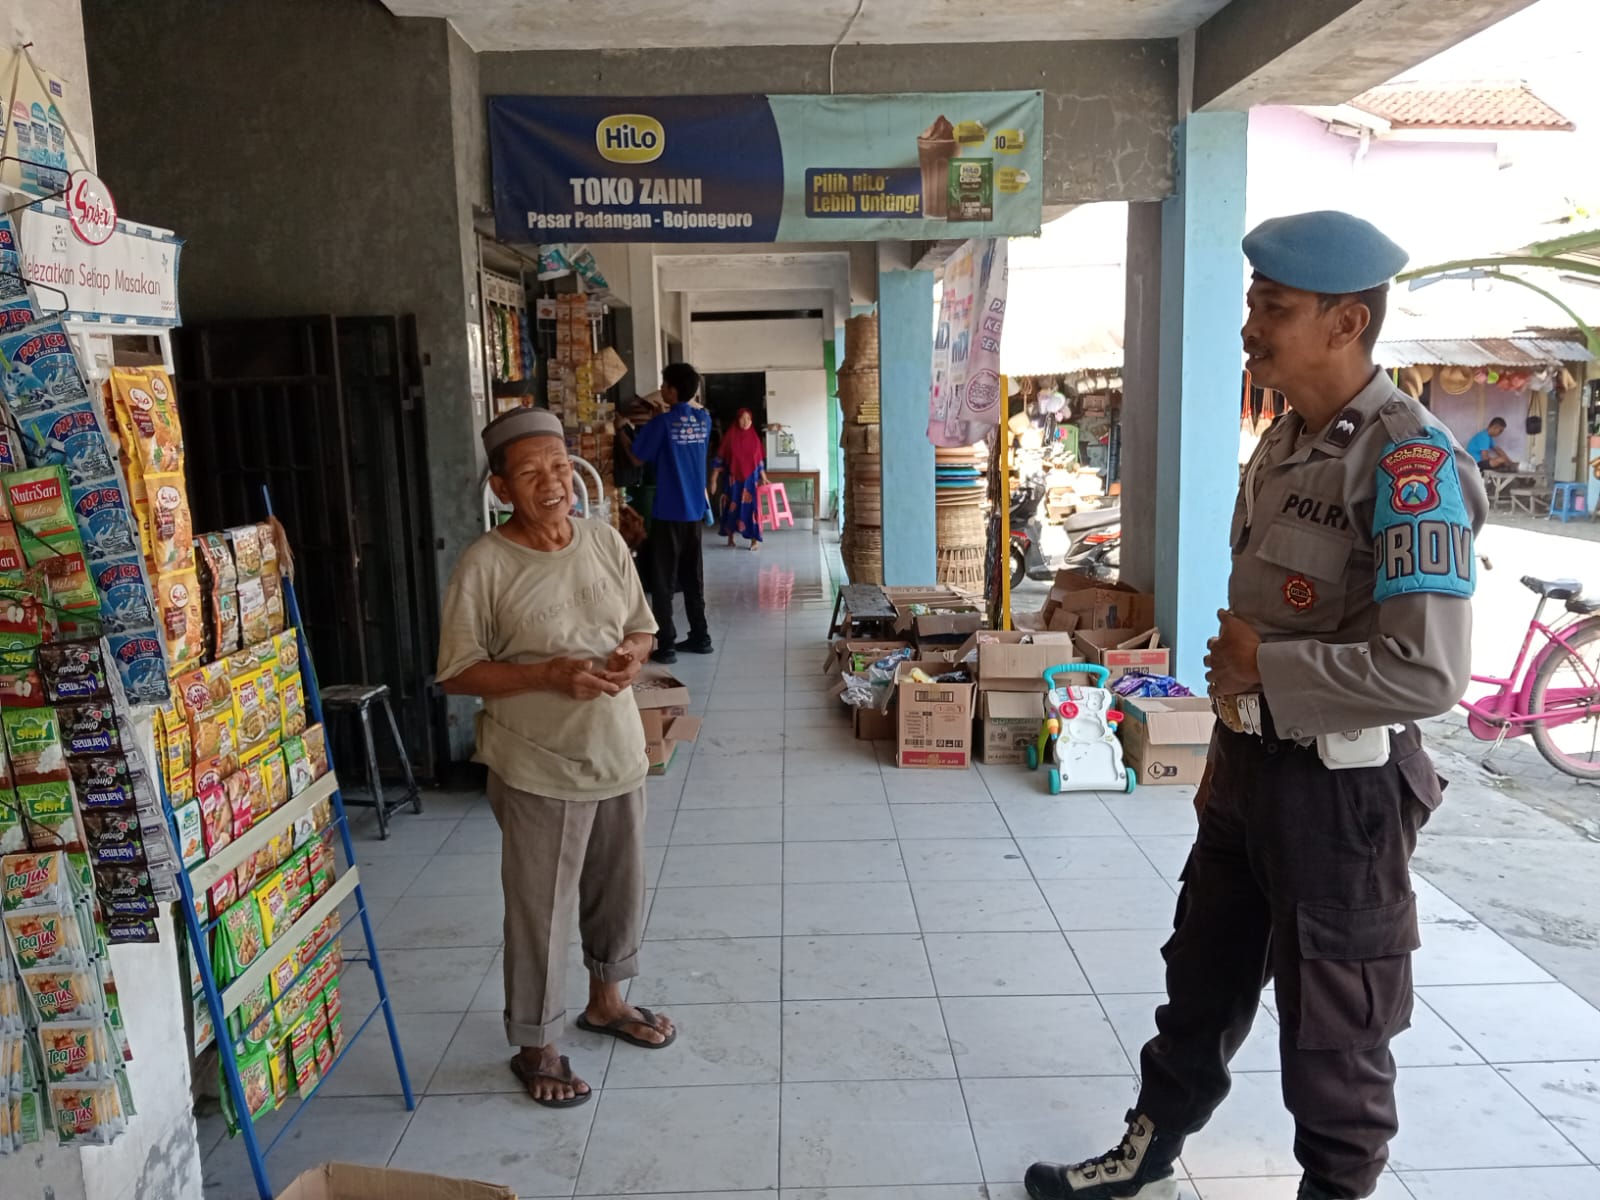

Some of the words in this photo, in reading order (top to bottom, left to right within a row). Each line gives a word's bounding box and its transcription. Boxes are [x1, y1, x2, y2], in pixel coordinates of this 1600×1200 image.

[605, 124, 657, 149] HiLo
[569, 177, 634, 206] TOKO
[638, 177, 703, 206] ZAINI
[813, 173, 848, 193] Pilih
[813, 193, 856, 213] Lebih
[860, 191, 920, 214] Untung!
[527, 211, 572, 229] Pasar
[574, 210, 652, 230] Padangan
[663, 210, 753, 230] Bojonegoro
[79, 262, 111, 296] Setiap
[115, 268, 161, 296] Masakan
[18, 337, 42, 363] POP
[42, 333, 66, 349] ICE
[53, 415, 74, 440] POP
[1385, 446, 1441, 464] POLRES
[10, 483, 57, 505] NutriSari
[79, 491, 100, 513] POP
[71, 736, 110, 749] Marimas
[87, 791, 125, 803] Marimas
[99, 847, 135, 859] Marimas
